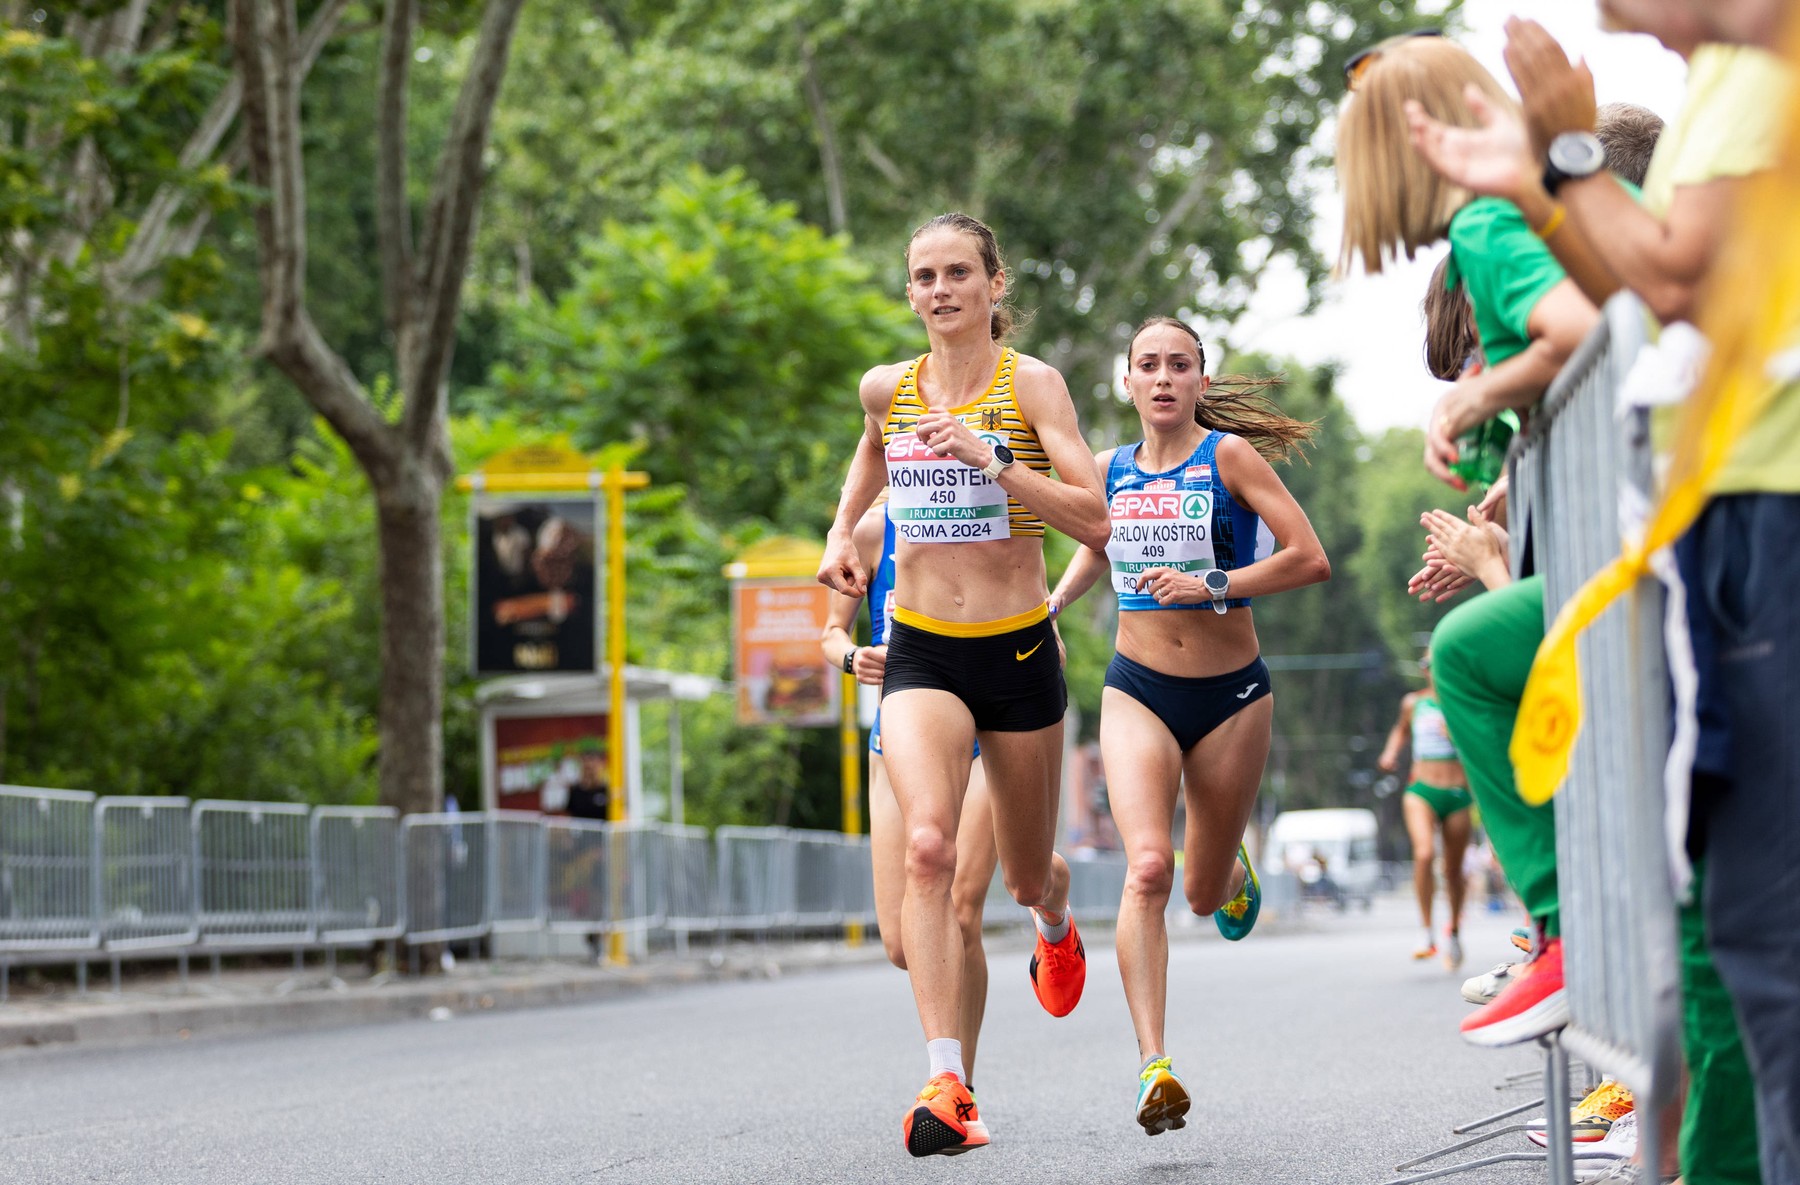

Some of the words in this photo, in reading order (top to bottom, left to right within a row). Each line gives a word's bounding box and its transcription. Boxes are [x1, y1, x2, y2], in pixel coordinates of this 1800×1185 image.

[891, 466, 992, 487] KÖNIGSTEI
[929, 490, 956, 504] 450
[909, 509, 913, 519] I
[914, 509, 936, 519] RUN
[1112, 496, 1179, 517] SPAR
[900, 524, 948, 538] ROMA
[951, 522, 992, 537] 2024
[1110, 525, 1150, 542] ARLOV
[1152, 522, 1206, 542] KOŠTRO
[1141, 545, 1165, 558] 409
[1129, 563, 1150, 573] RUN
